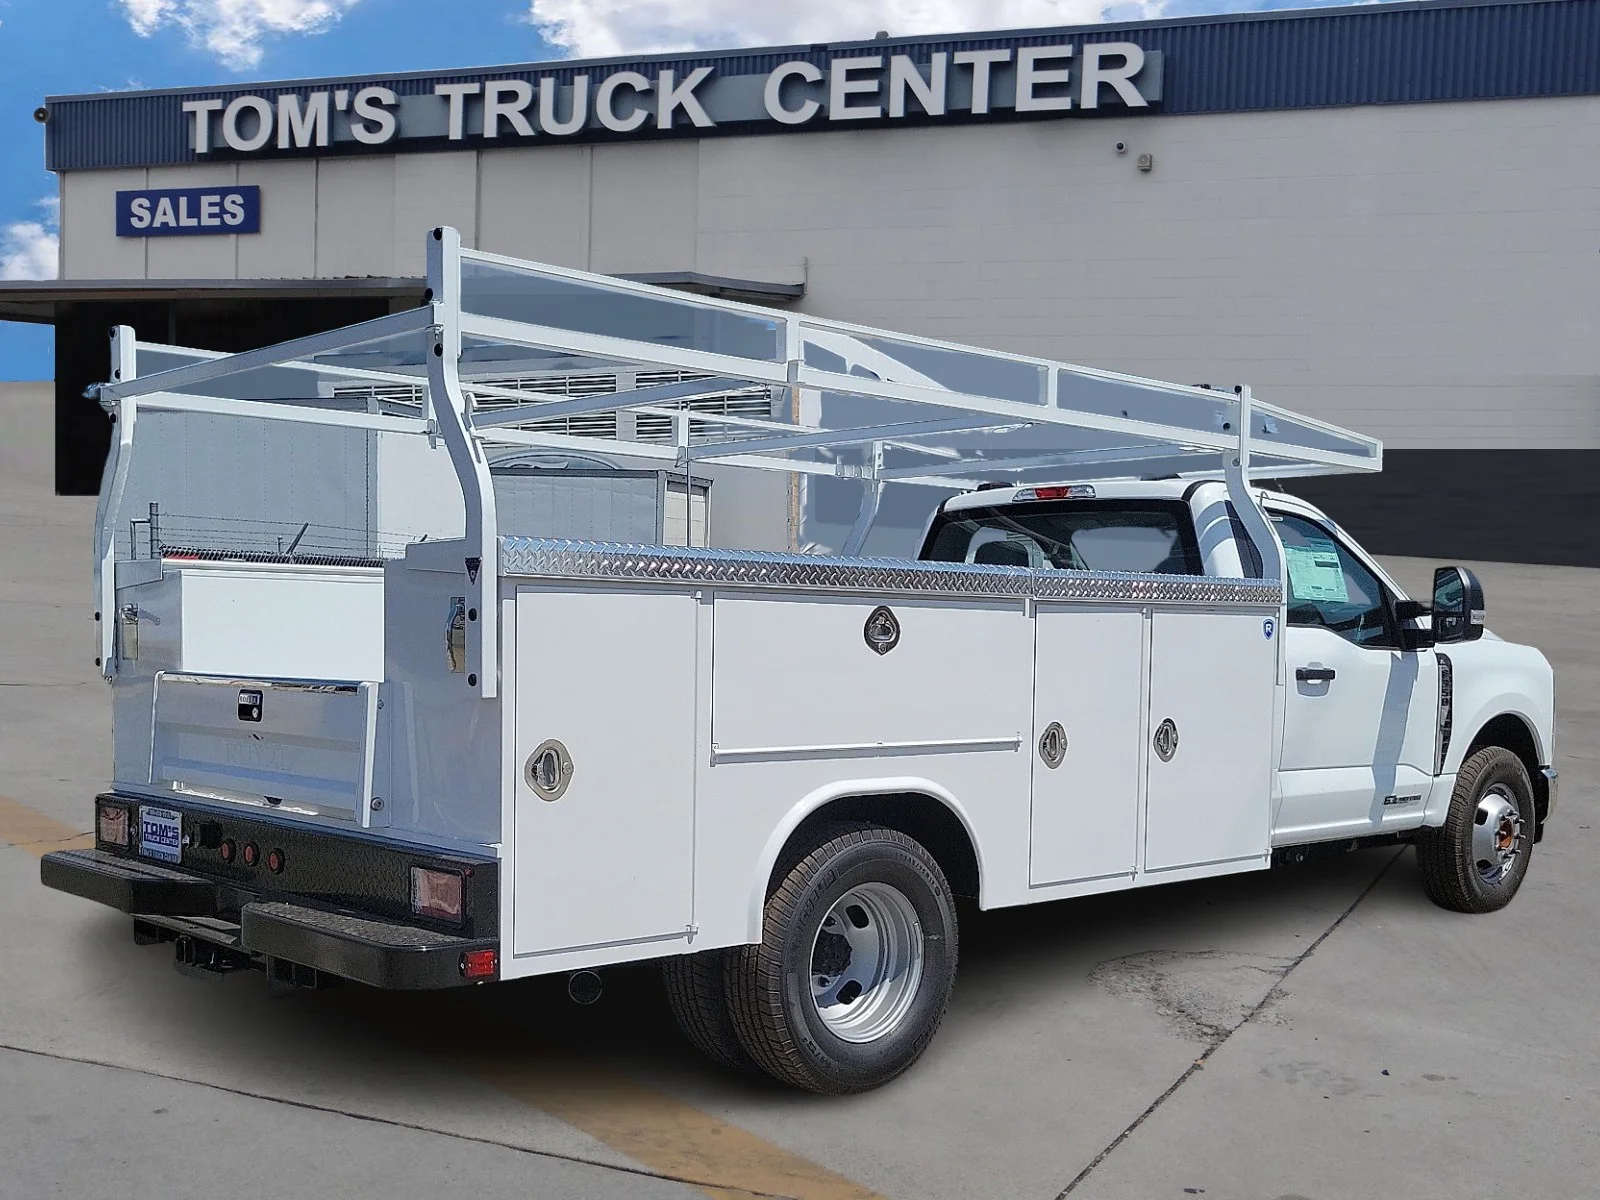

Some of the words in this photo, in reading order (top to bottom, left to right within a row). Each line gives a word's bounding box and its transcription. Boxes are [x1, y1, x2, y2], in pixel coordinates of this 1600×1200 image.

[182, 85, 398, 155] TOM'S
[434, 66, 716, 141] TRUCK
[763, 41, 1150, 126] CENTER
[130, 193, 245, 229] SALES
[143, 820, 180, 838] TOM'S
